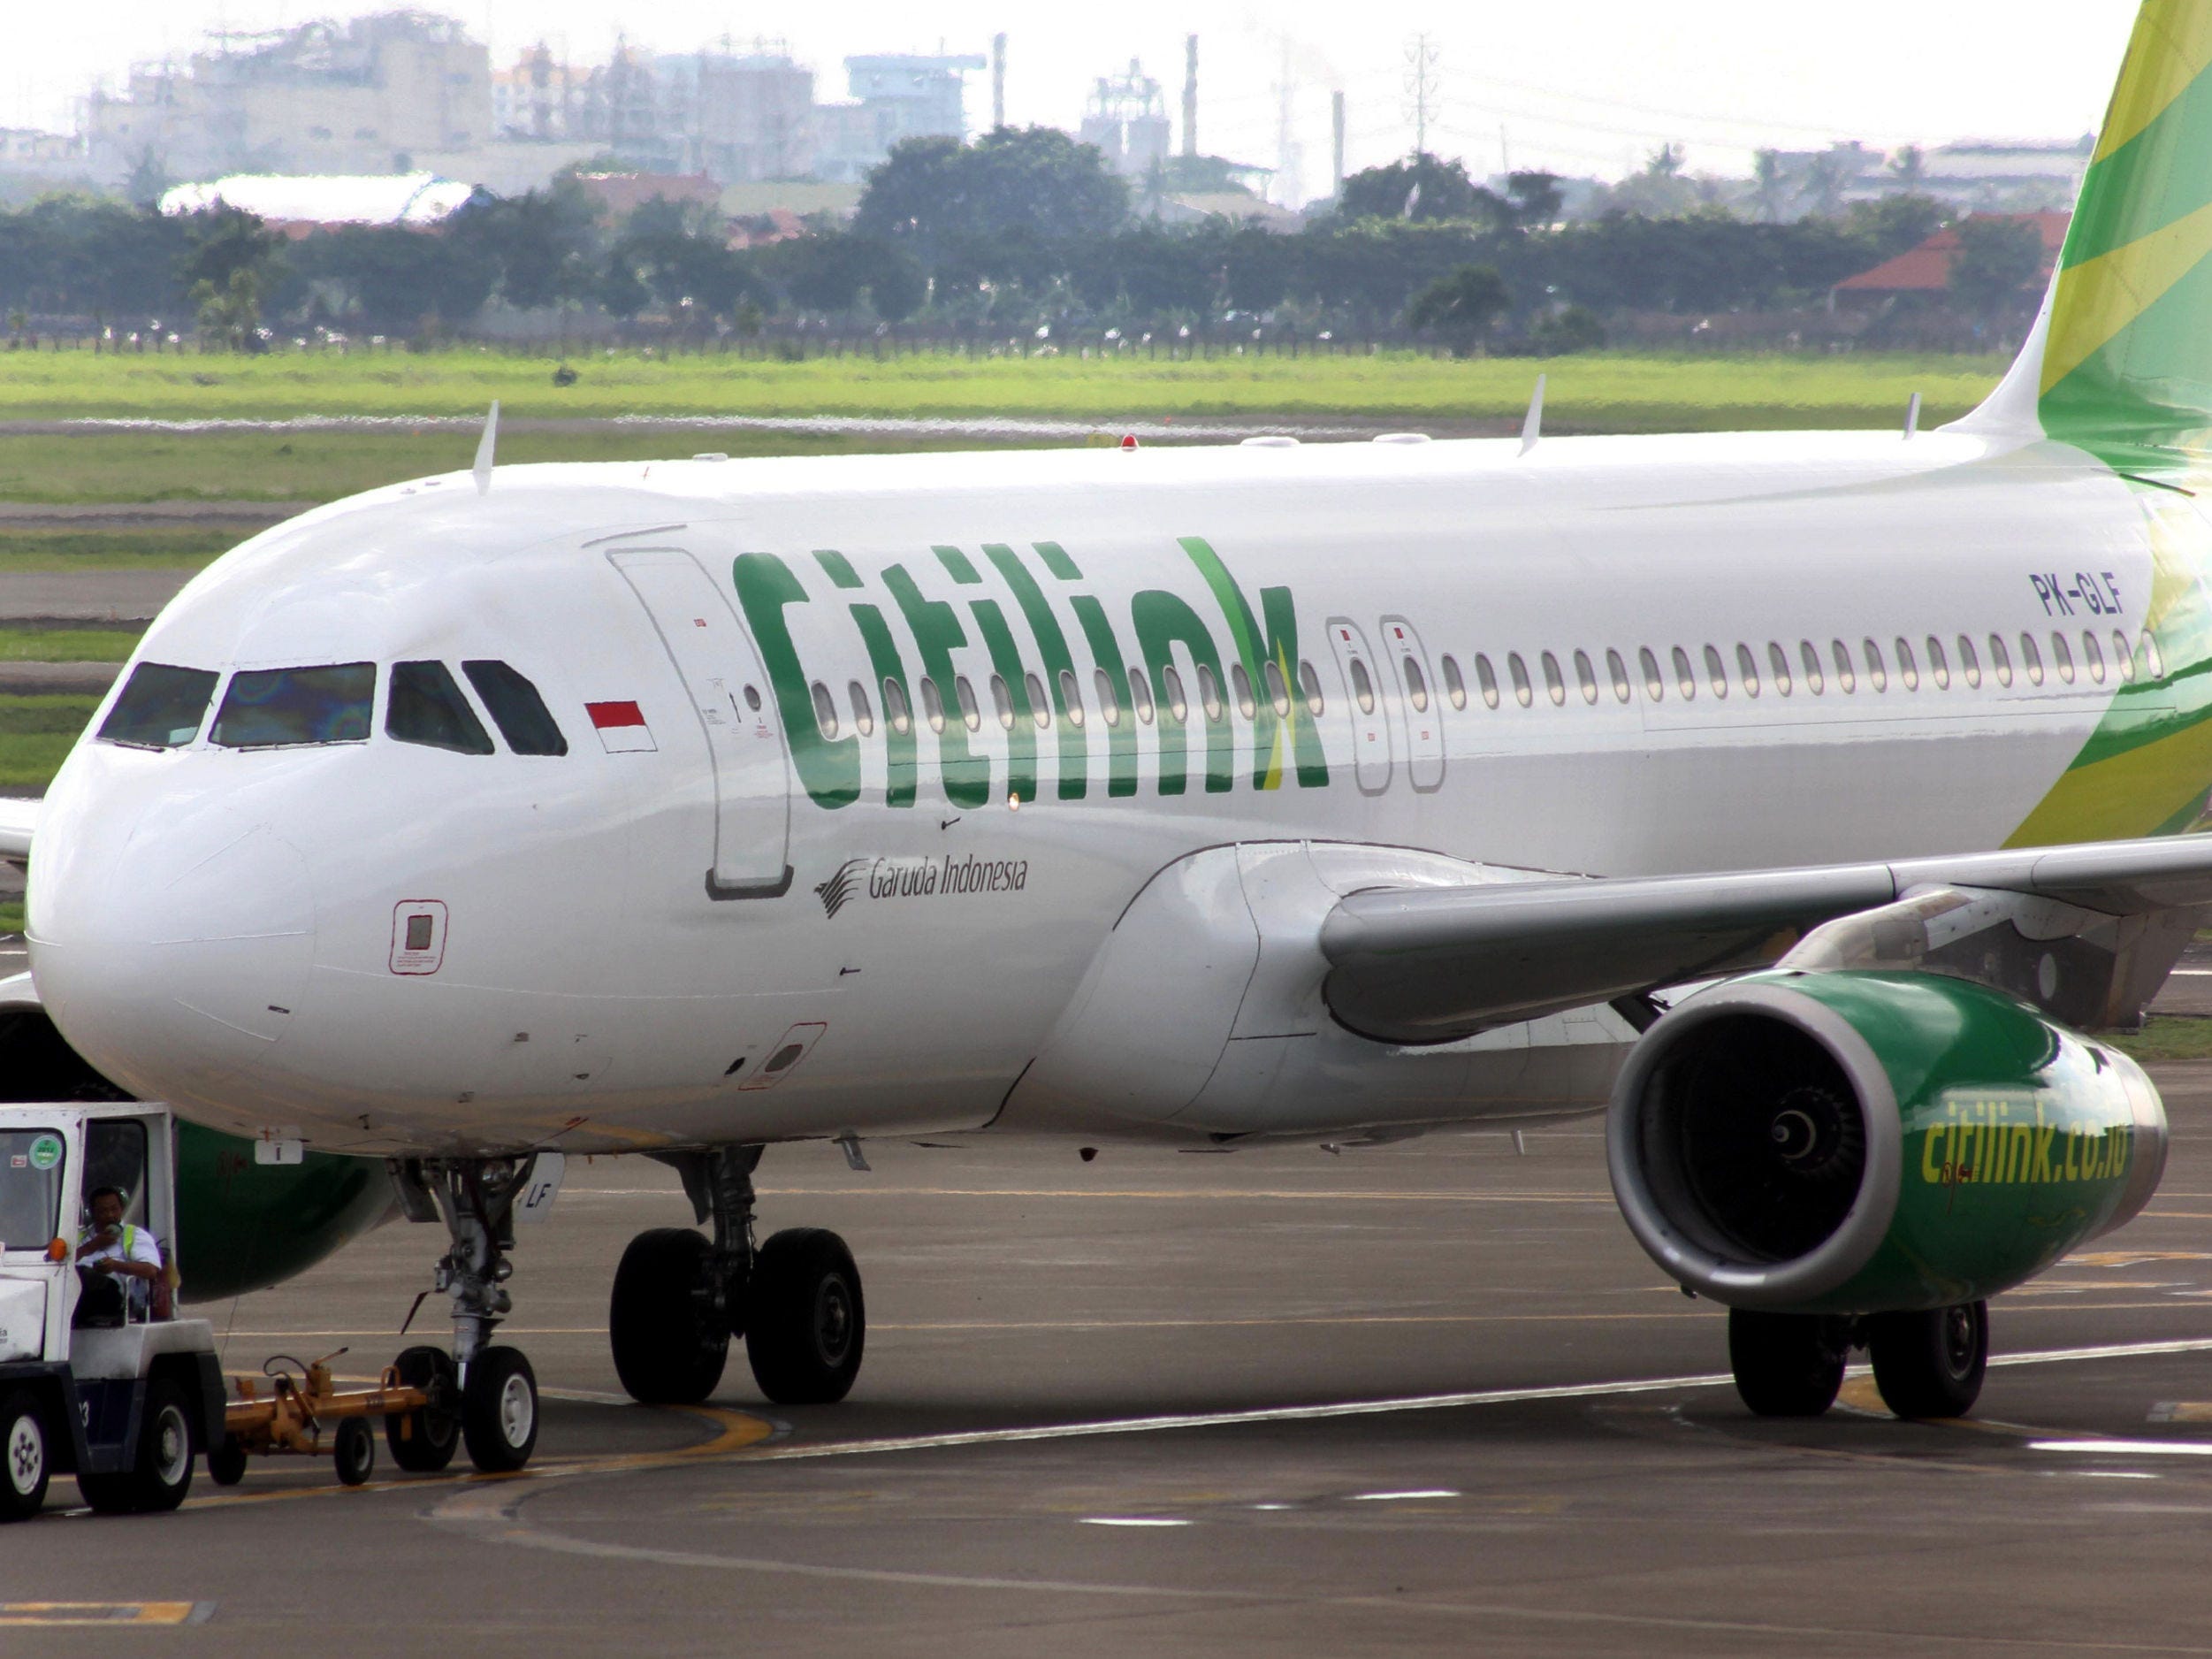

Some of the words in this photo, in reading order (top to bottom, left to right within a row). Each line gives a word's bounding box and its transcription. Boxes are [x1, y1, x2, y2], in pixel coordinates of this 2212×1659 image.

[2029, 571, 2123, 616] PK-GLF
[732, 536, 1330, 810] Citilink
[869, 855, 937, 899] Garuda
[940, 853, 1028, 895] Indonesia
[525, 1183, 552, 1208] LF
